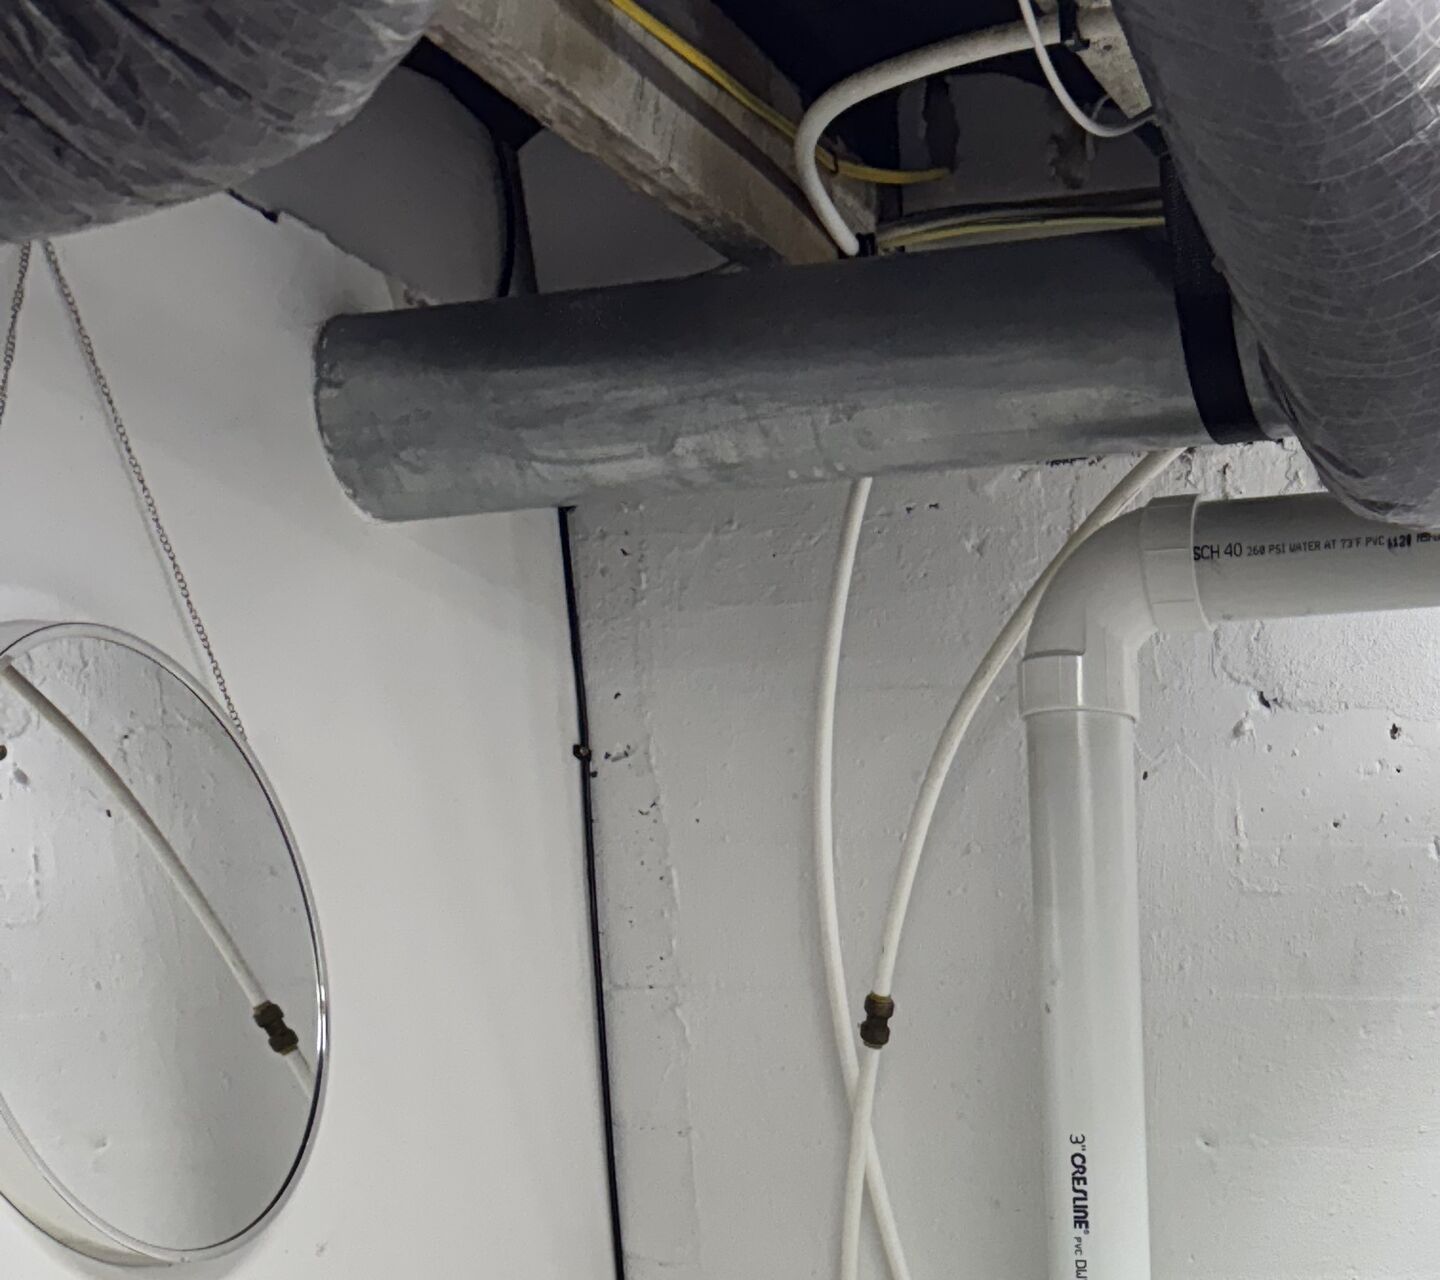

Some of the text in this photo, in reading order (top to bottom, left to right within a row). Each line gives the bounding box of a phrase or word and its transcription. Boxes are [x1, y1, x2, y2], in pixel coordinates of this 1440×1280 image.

[1193, 543, 1220, 561] SCH
[1223, 542, 1243, 558] 40
[1246, 545, 1266, 557] 260
[1268, 543, 1286, 555] PSI
[1289, 541, 1321, 553] WATER
[1324, 538, 1338, 550] AT
[1365, 535, 1385, 547] PVC
[1074, 1236, 1083, 1256] PVC
